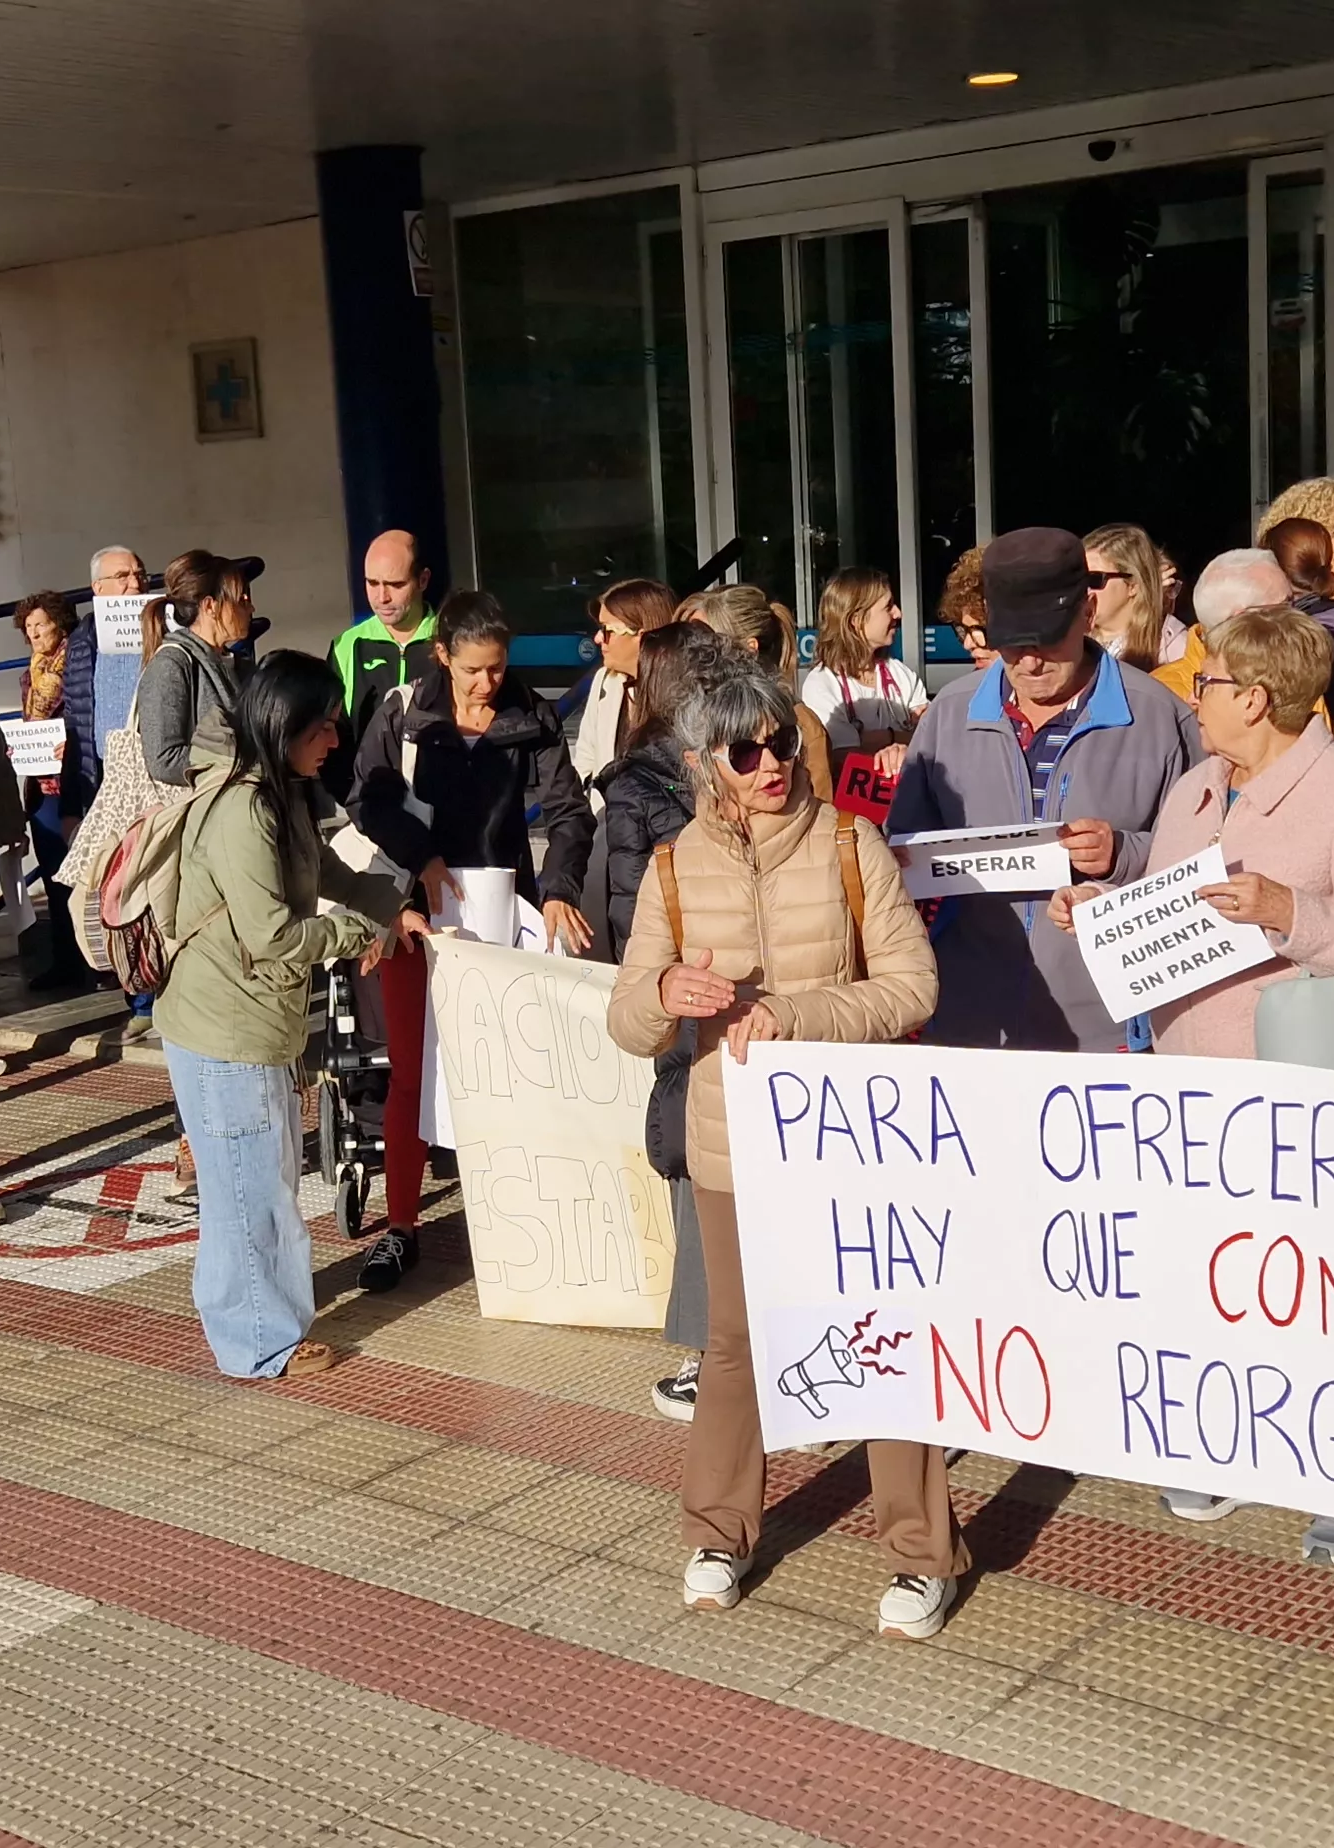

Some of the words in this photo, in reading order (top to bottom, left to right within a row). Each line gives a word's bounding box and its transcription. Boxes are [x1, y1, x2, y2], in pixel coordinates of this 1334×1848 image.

[107, 600, 121, 608] LA
[124, 599, 146, 608] PRE
[6, 726, 61, 738] EFENDAMOS
[846, 767, 891, 806] RE
[931, 855, 1037, 878] ESPERAR
[1091, 900, 1115, 920] LA
[1119, 860, 1200, 907] PRESIÓN
[1093, 890, 1207, 950] ASISTENCIA
[1120, 917, 1217, 969] AUMENTA
[1129, 971, 1165, 996] SIN
[1166, 939, 1237, 980] PARAR
[768, 1071, 977, 1177] PARA
[831, 1197, 951, 1294] HAY
[1042, 1208, 1141, 1301] QUE
[930, 1318, 1051, 1441] NO
